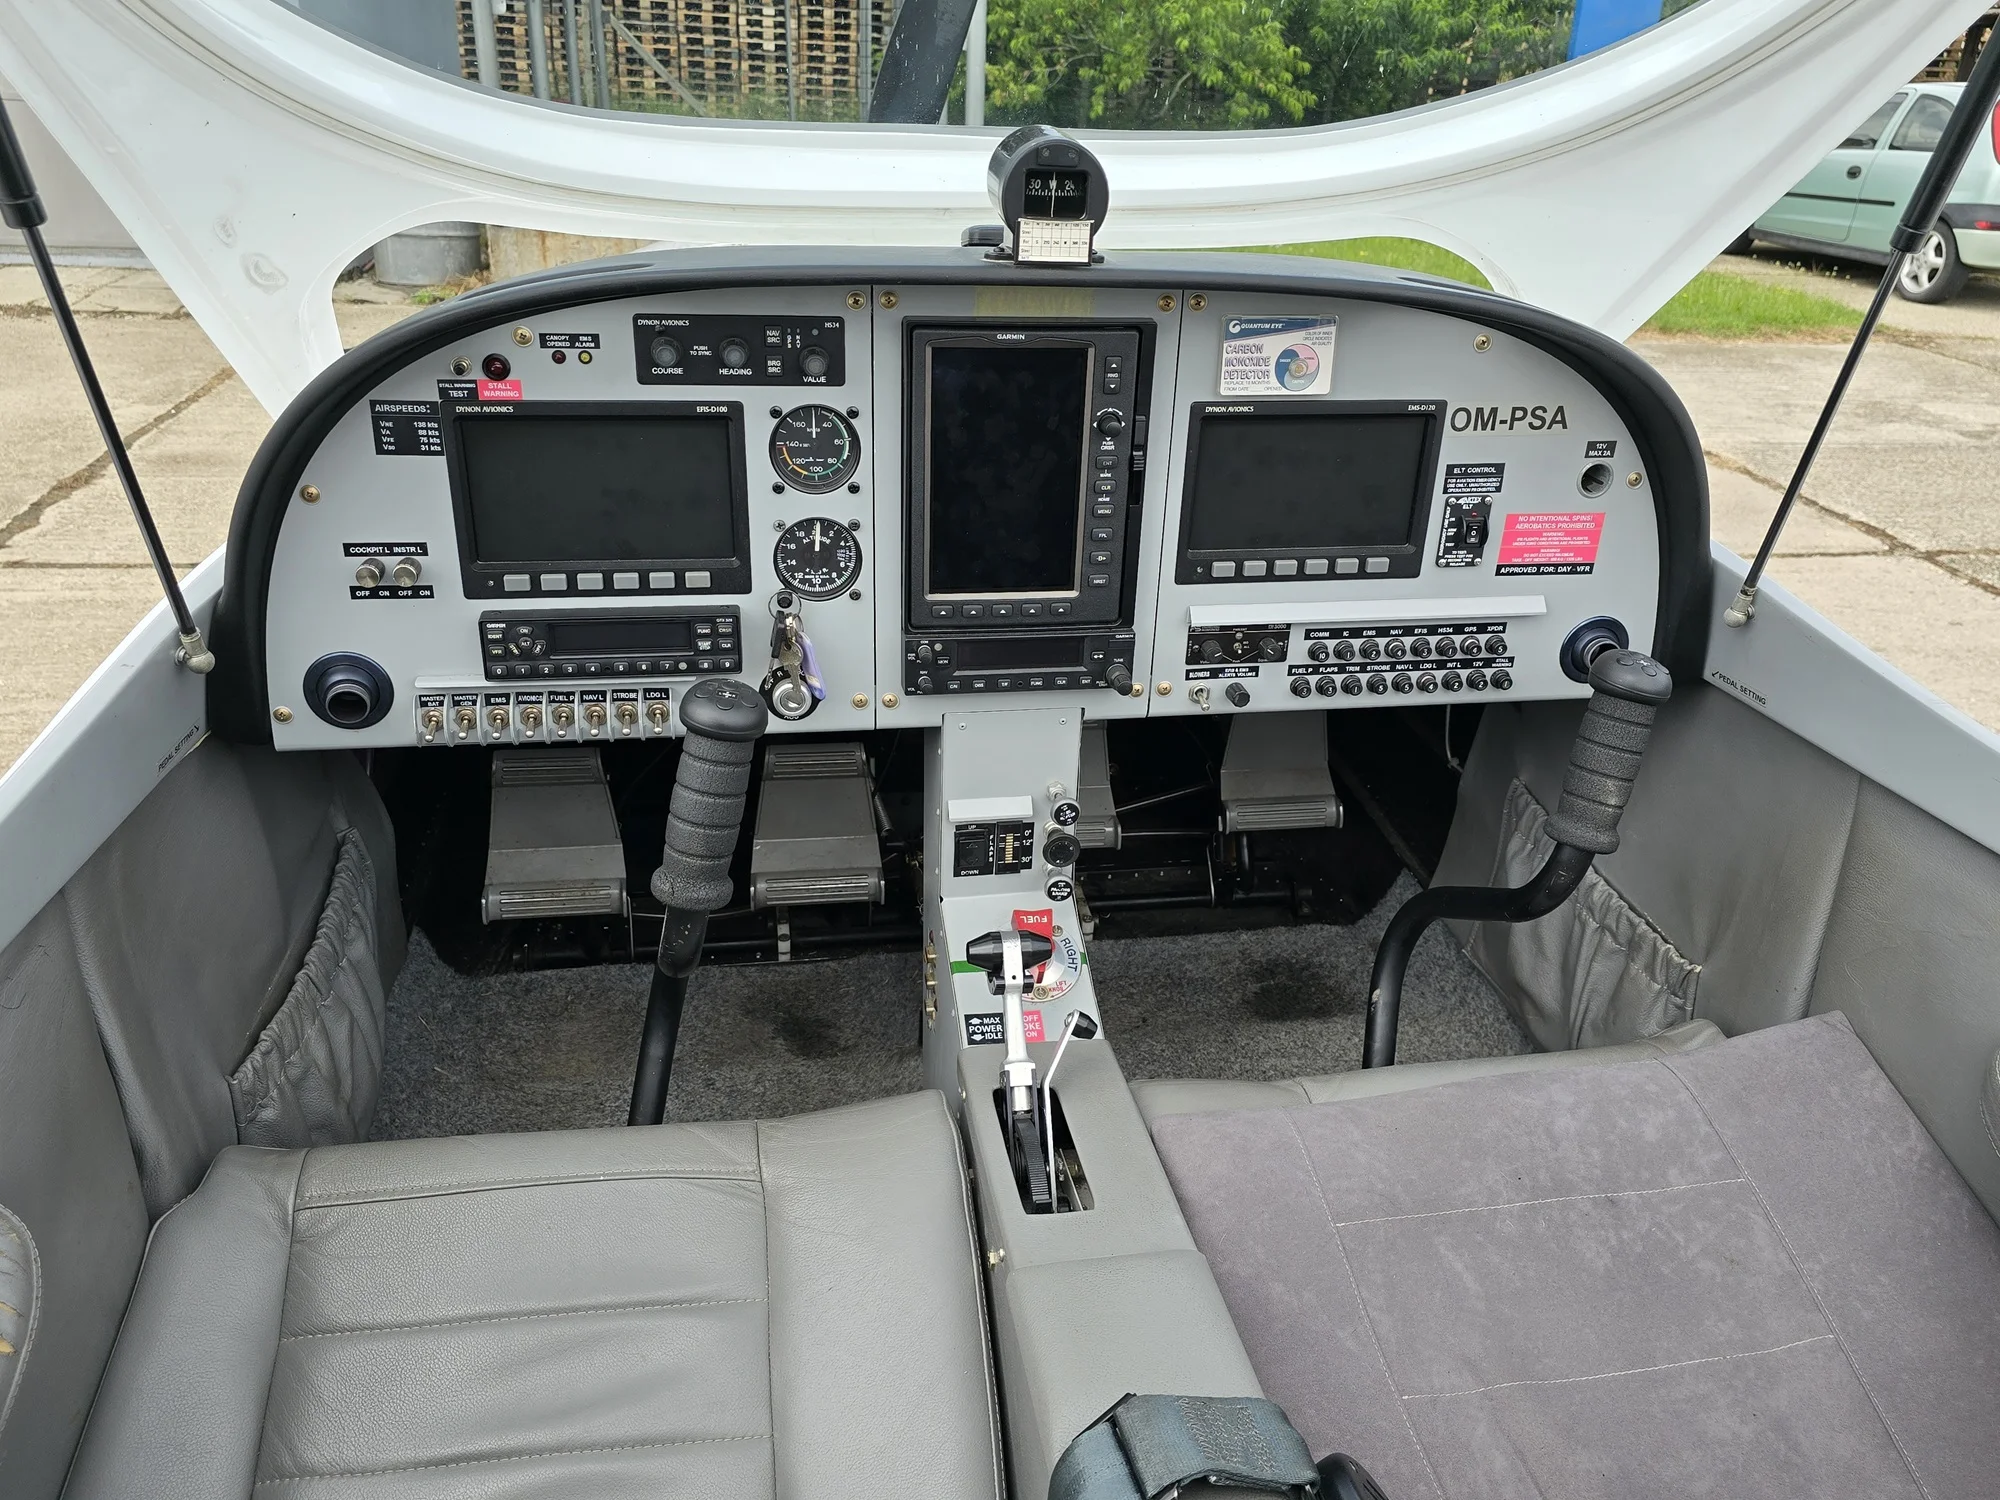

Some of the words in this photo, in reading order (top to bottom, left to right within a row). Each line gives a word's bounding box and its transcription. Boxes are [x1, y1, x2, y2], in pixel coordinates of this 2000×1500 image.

[1029, 179, 1041, 189] 30
[1226, 343, 1264, 354] CARBON
[1224, 356, 1271, 367] MONOXIDE
[1224, 369, 1270, 380] DETECTOR
[483, 390, 519, 398] WARNING
[375, 404, 430, 413] AIRSPEEDS:
[1450, 406, 1568, 432] OM-PSA
[802, 535, 831, 544] ALTIUDE
[1718, 673, 1739, 690] PEDAL
[1740, 685, 1766, 705] SETTING
[158, 752, 174, 772] PEDAL
[175, 729, 195, 754] SETTING
[1060, 937, 1078, 972] RIGHT
